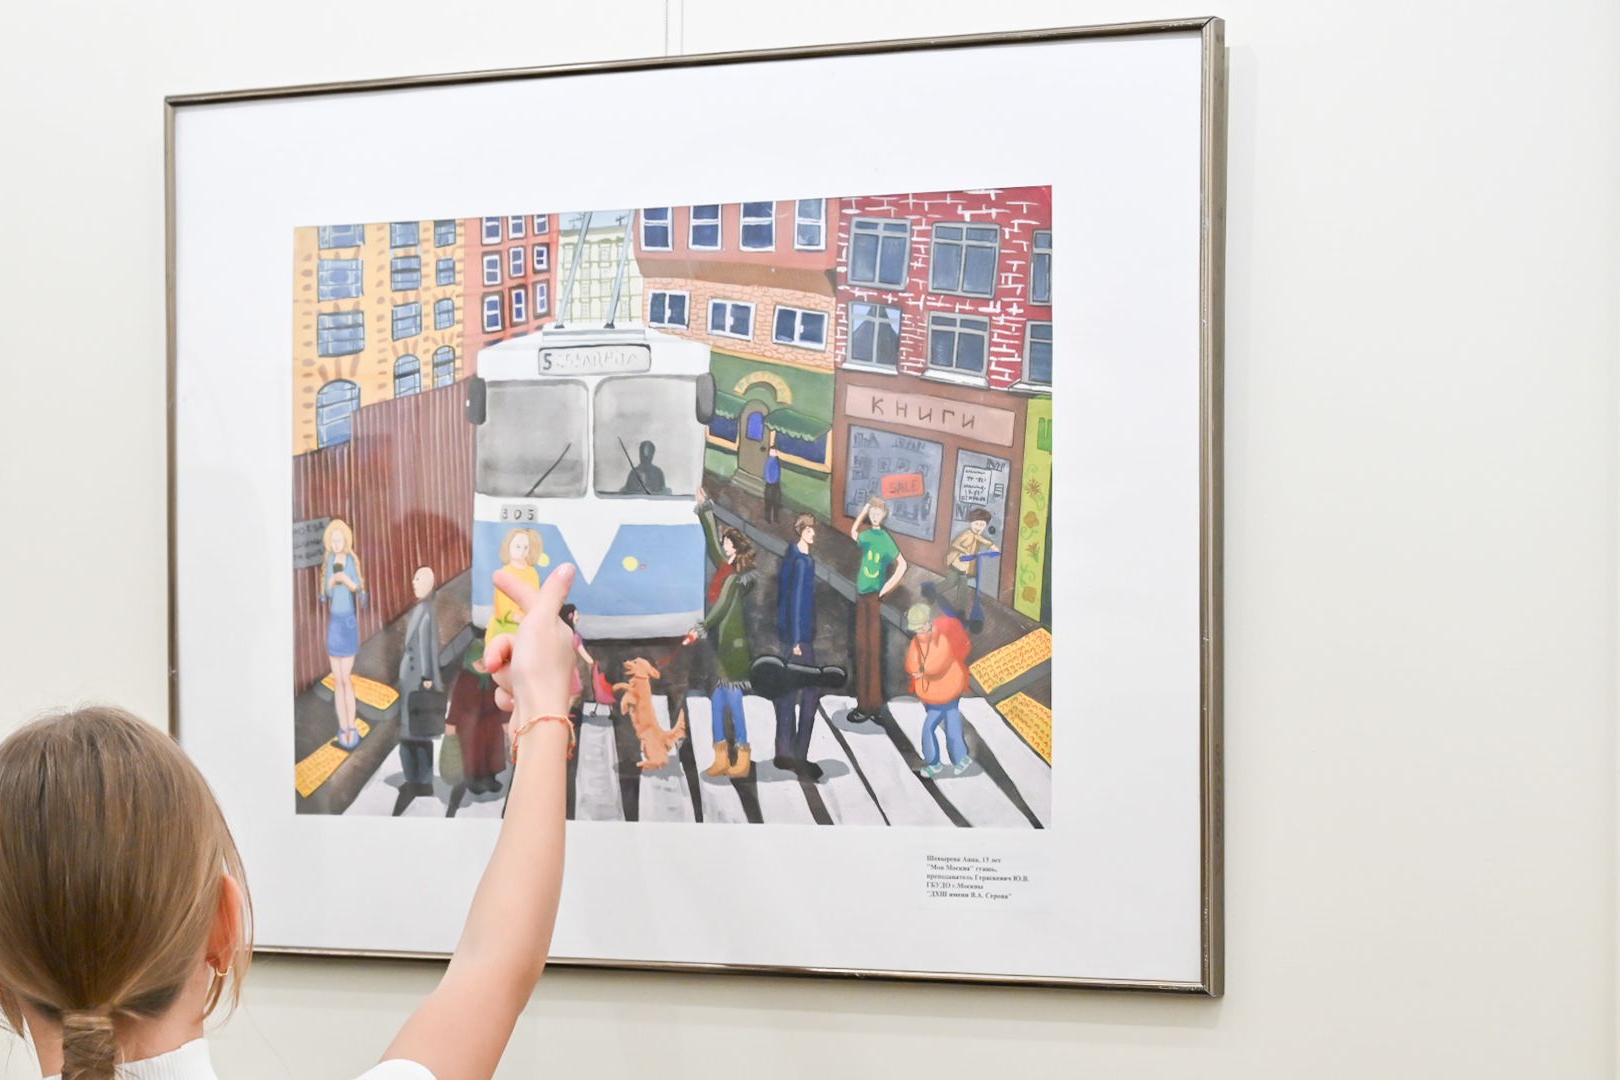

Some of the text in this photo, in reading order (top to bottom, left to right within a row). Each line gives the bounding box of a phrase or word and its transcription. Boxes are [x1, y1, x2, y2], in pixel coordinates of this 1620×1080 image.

[542, 352, 553, 371] 5
[871, 395, 975, 430] КНИГИ
[888, 477, 920, 495] SALE
